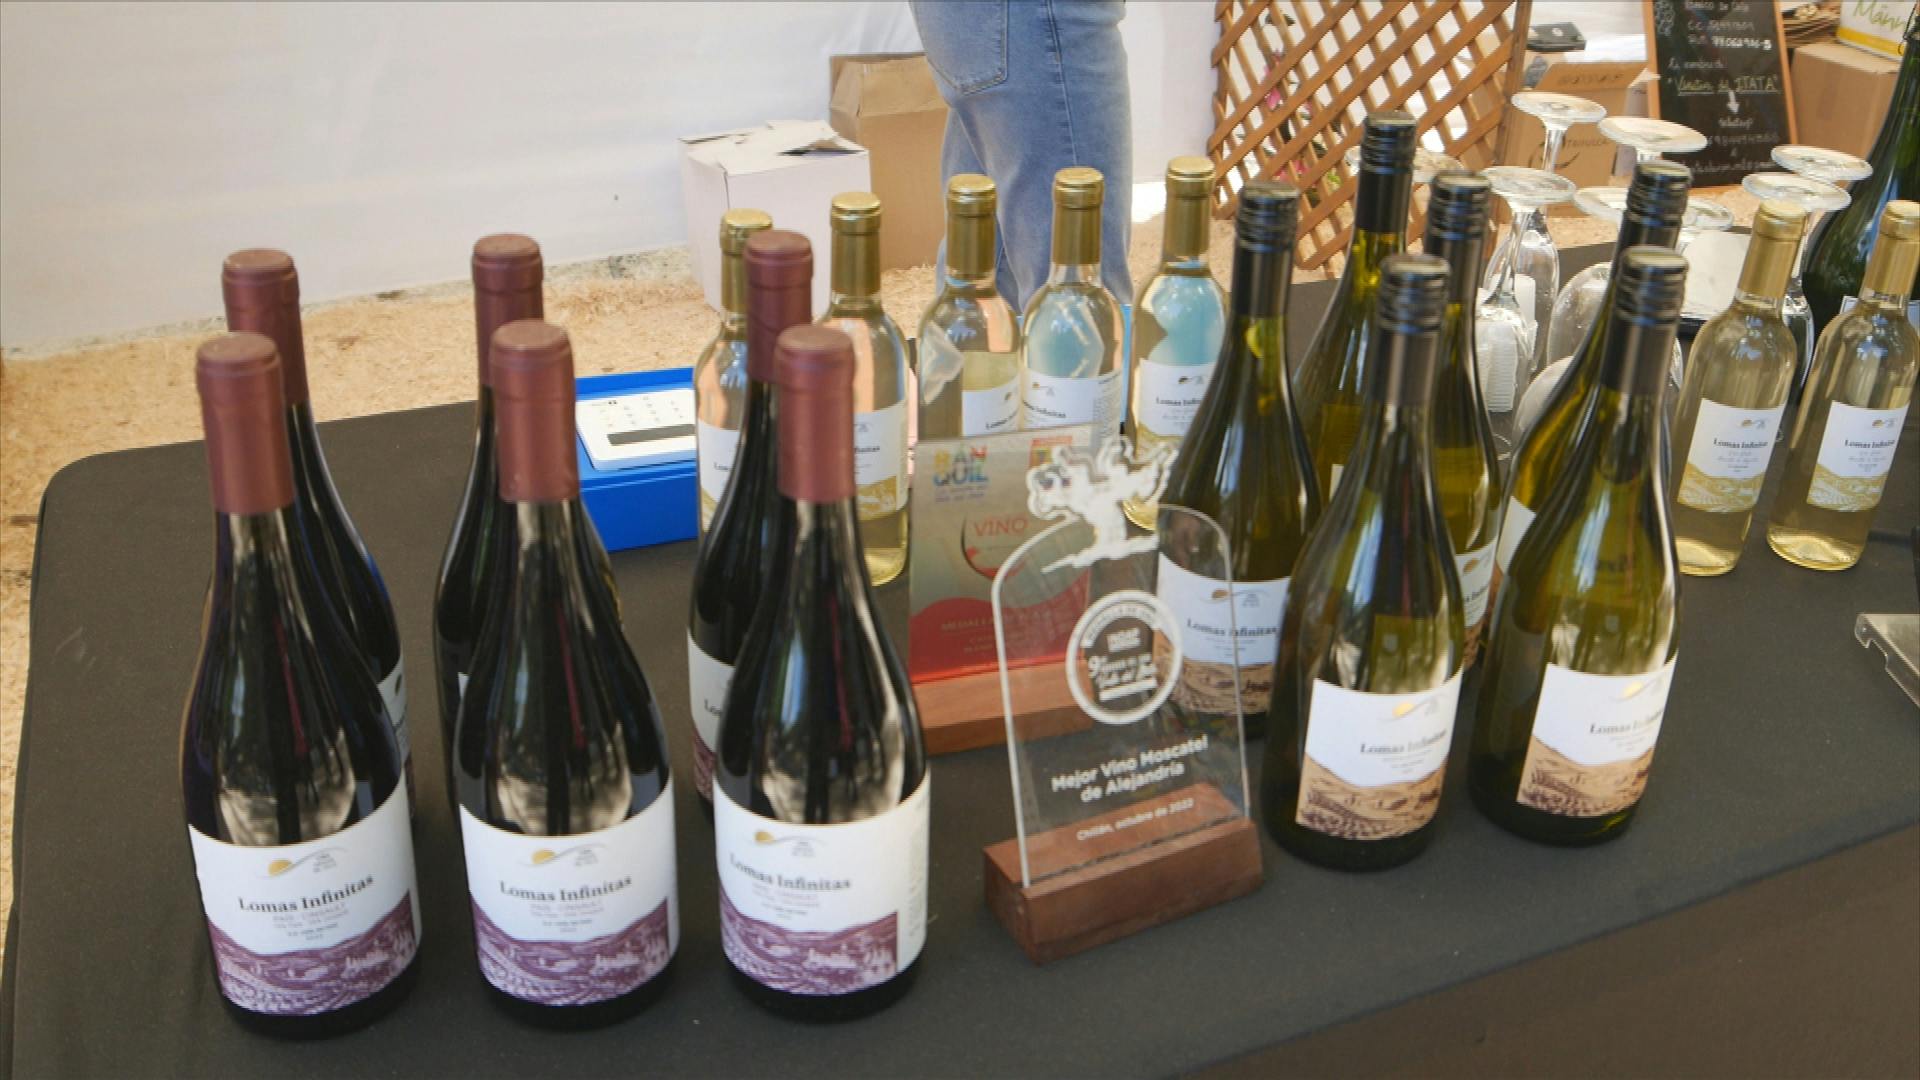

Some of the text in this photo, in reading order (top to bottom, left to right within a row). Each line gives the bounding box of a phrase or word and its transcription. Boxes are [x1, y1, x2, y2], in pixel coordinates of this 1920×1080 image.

[1713, 437, 1740, 449] Lomas
[1844, 438, 1871, 449] Lomas
[974, 512, 1028, 537] VINO
[1187, 617, 1225, 636] Lomas
[1590, 722, 1630, 735] Lomas
[1360, 742, 1405, 754] Lomas
[1051, 734, 1208, 793] Mejor Vino Moscatel
[1080, 785, 1102, 803] de
[730, 852, 852, 893] Lomas Infinitas
[238, 874, 374, 913] Lomas Infinitas
[499, 875, 633, 903] Lomas Infinitas
